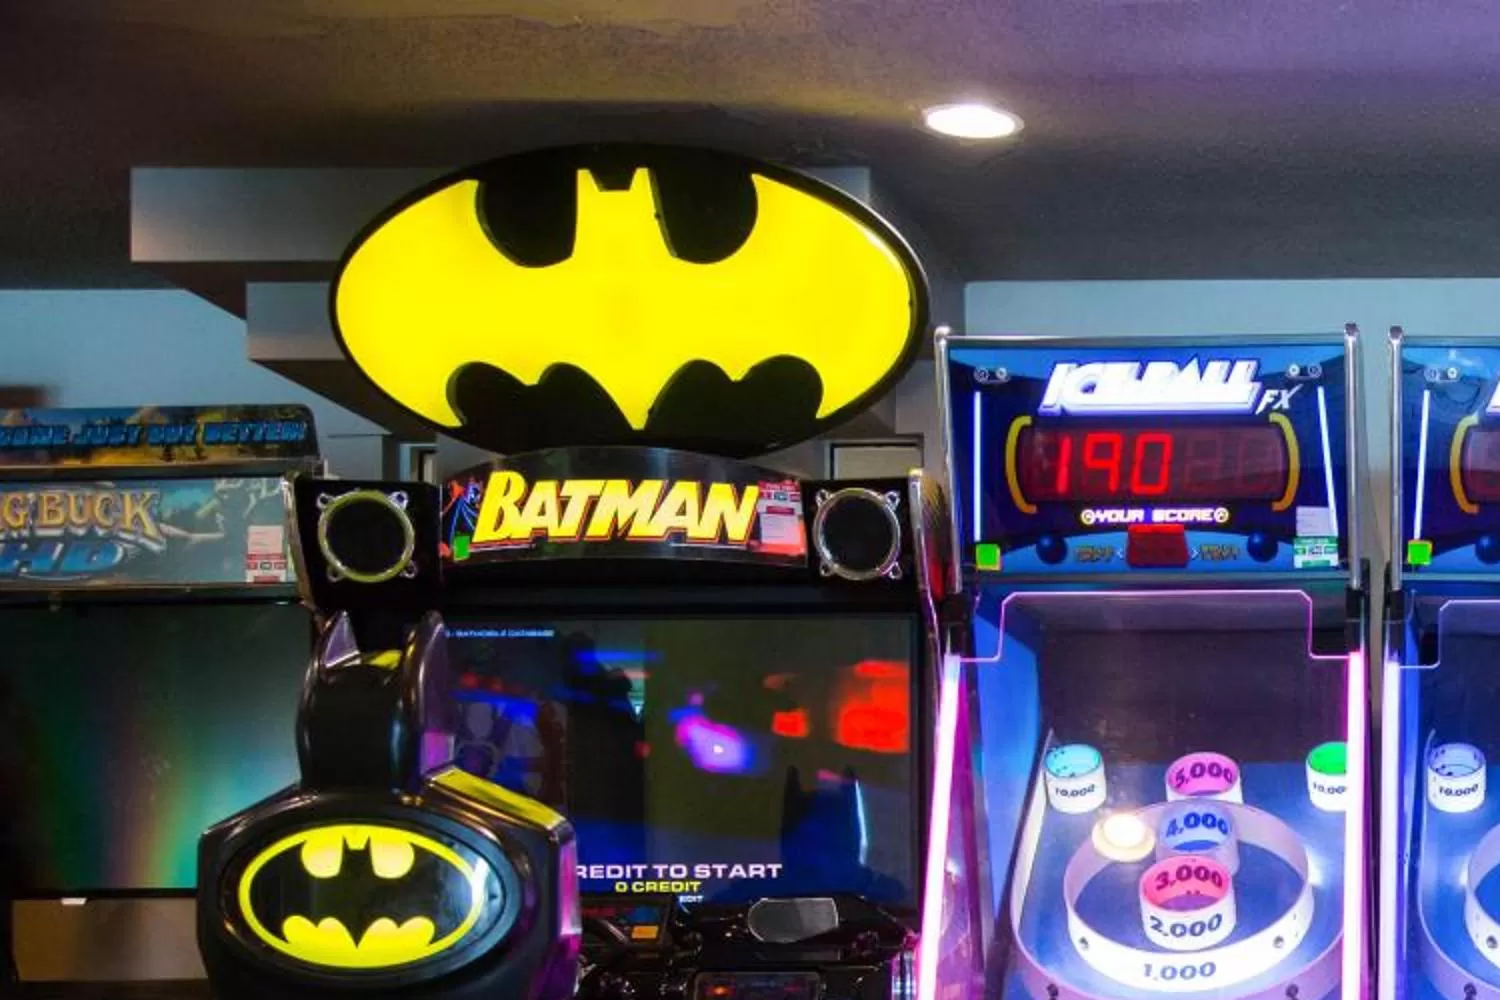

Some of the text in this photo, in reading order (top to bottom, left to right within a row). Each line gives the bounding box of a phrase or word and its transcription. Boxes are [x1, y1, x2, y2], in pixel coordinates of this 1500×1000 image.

[1255, 384, 1303, 415] FX
[1056, 433, 1173, 495] 190
[37, 491, 163, 545] BUCK
[472, 471, 760, 544] BATMAN
[1095, 508, 1215, 523] YOUR SCORE
[576, 863, 783, 879] REDIT TO START
[632, 881, 701, 892] CREDIT
